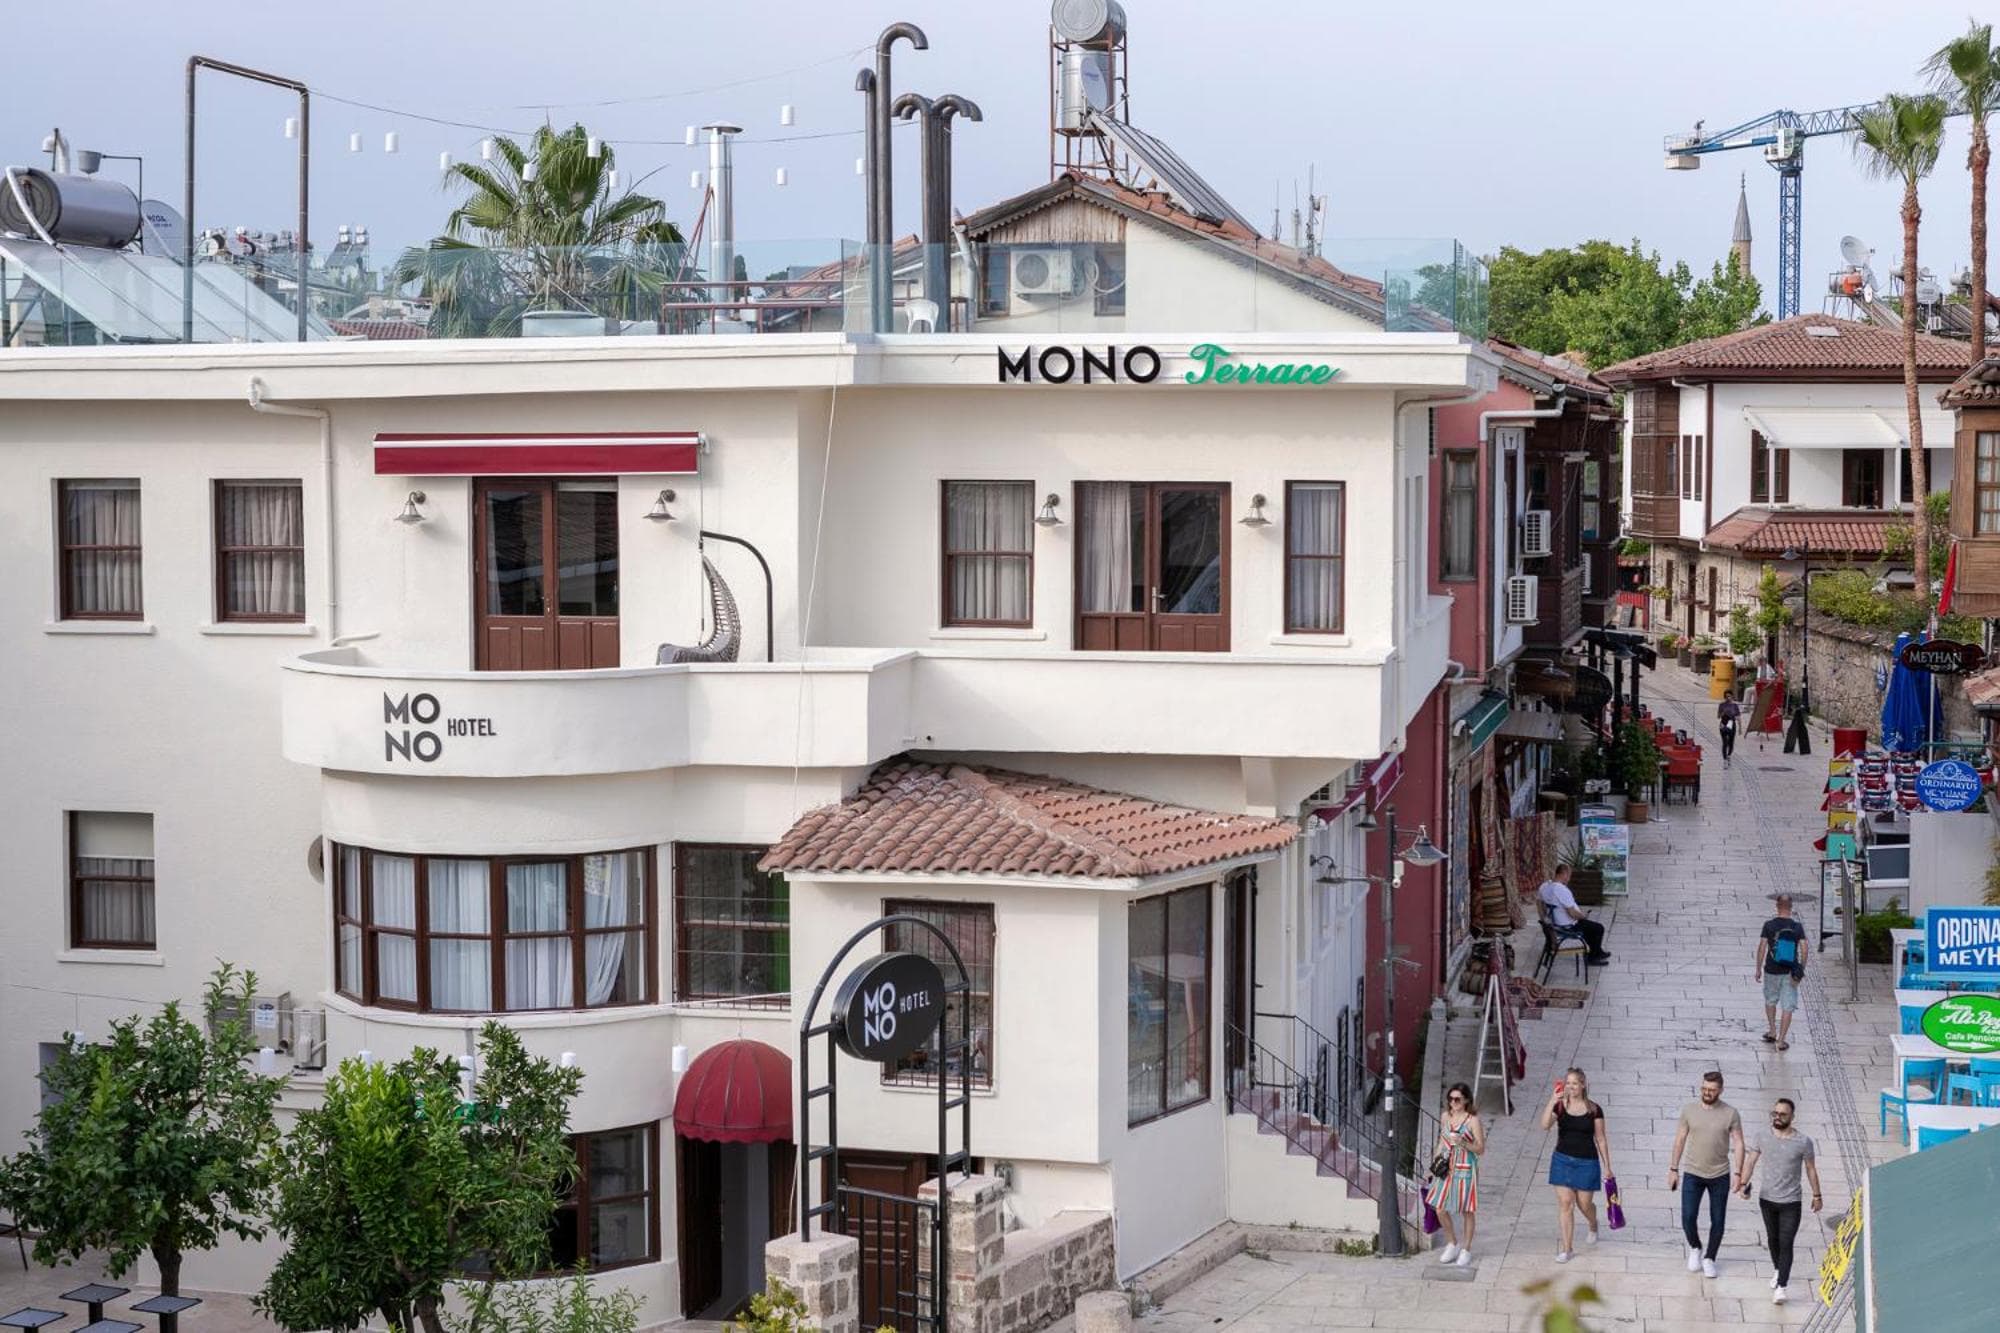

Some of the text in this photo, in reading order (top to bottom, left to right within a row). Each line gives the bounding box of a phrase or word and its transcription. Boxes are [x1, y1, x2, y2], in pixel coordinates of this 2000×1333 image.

[998, 343, 1342, 385] MONO Terrace
[383, 691, 441, 724] MO
[447, 718, 497, 737] HOTEL
[385, 730, 442, 763] NO
[864, 981, 896, 1017] MO
[900, 990, 931, 1014] HOTEL
[864, 1011, 896, 1047] NO
